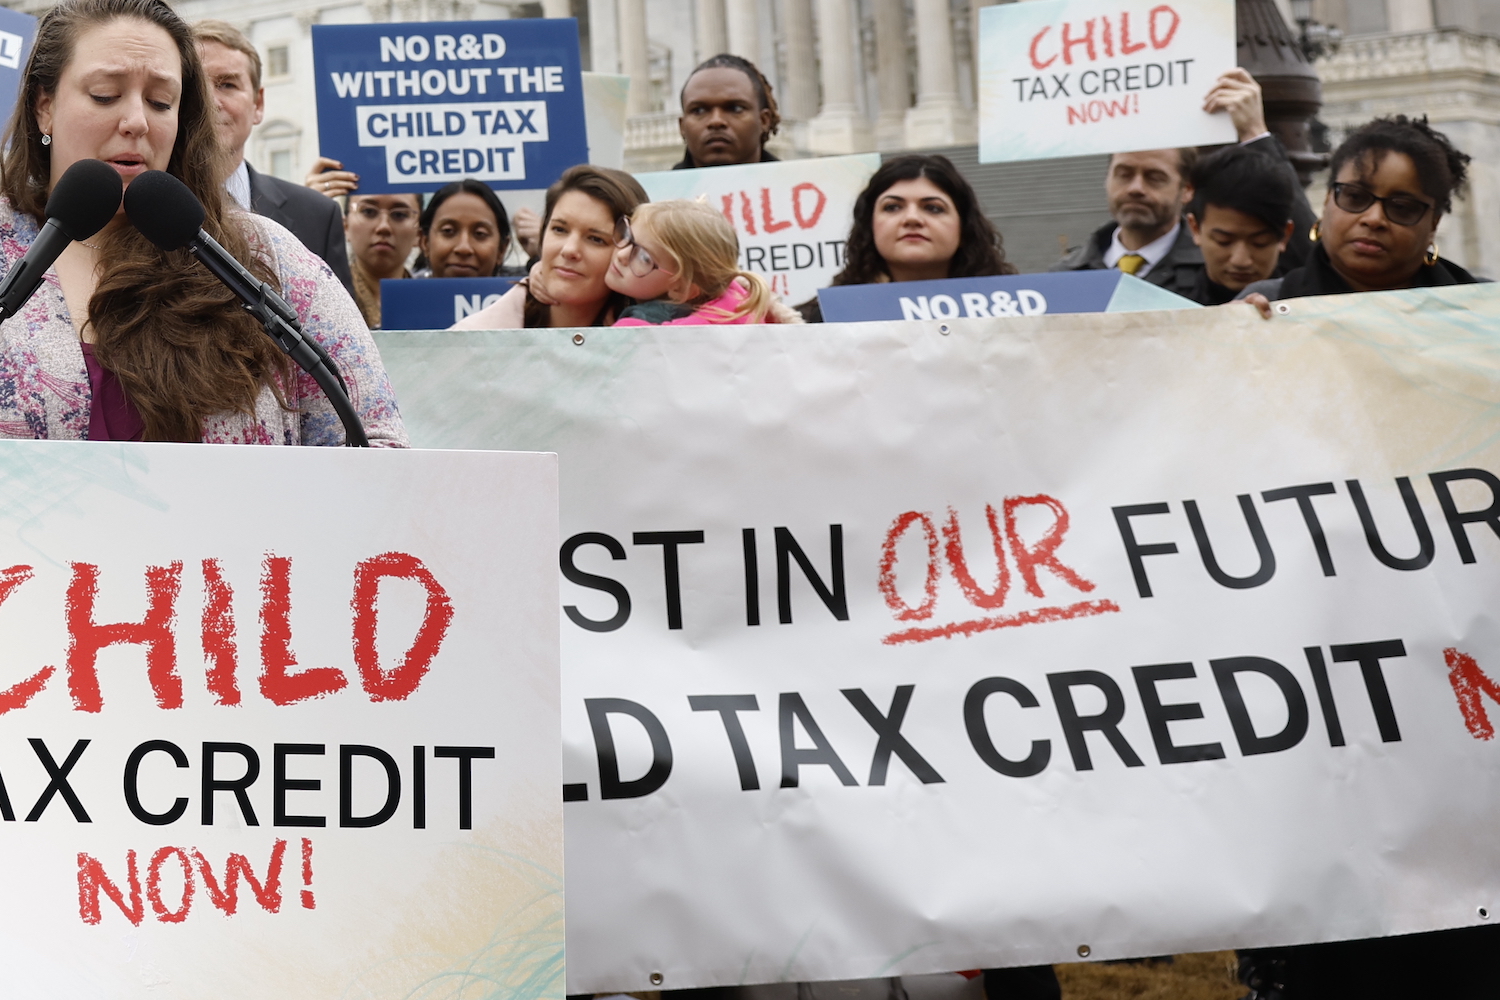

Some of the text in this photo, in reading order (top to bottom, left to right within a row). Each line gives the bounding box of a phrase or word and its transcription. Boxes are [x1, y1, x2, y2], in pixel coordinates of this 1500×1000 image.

[380, 34, 506, 62] NO R&D
[1029, 5, 1180, 70] CHILD
[331, 66, 564, 98] WITHOUT THE
[1012, 59, 1195, 102] TAX CREDIT
[367, 108, 538, 139] CHILD TAX
[1067, 93, 1140, 125] NOW!
[395, 147, 514, 175] CREDIT
[721, 182, 827, 236] ILD
[739, 240, 846, 272] REDIT
[899, 289, 1047, 320] NO R&D
[741, 523, 850, 627] IN
[878, 492, 1097, 622] OUR
[1111, 467, 1500, 598] FUTUR
[688, 684, 946, 792] TAX
[962, 638, 1408, 778] CREDIT
[122, 738, 496, 831] CREDIT
[75, 837, 316, 928] NOW!
